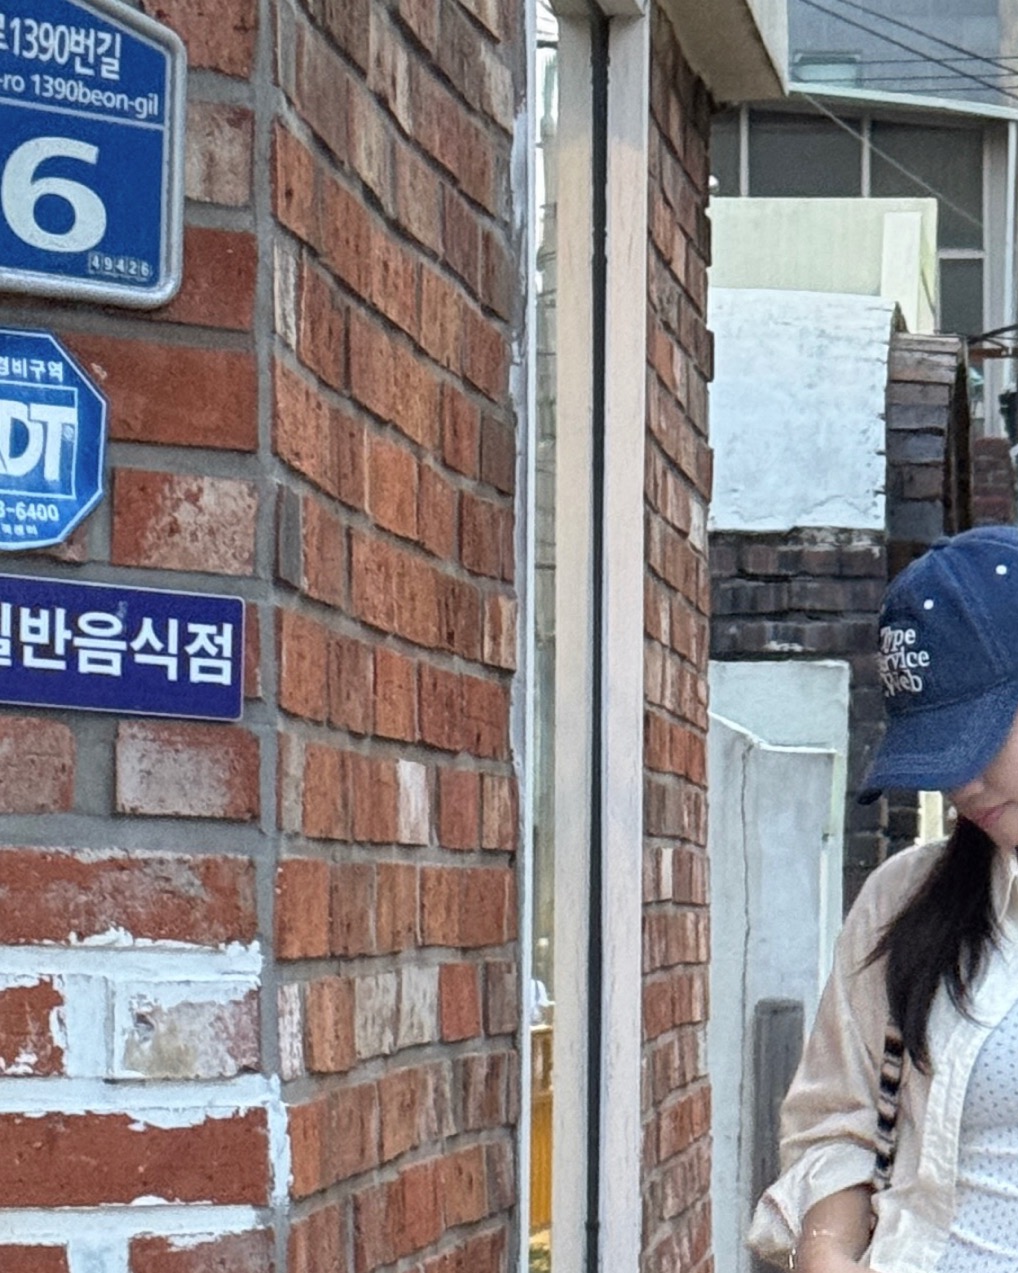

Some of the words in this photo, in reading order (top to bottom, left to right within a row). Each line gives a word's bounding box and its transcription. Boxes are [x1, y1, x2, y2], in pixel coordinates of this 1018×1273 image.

[31, 74, 159, 119] 1390beon-gil
[1, 136, 107, 253] 6
[90, 256, 150, 280] 49426
[0, 399, 78, 481] DT
[0, 602, 233, 686] 반음식점
